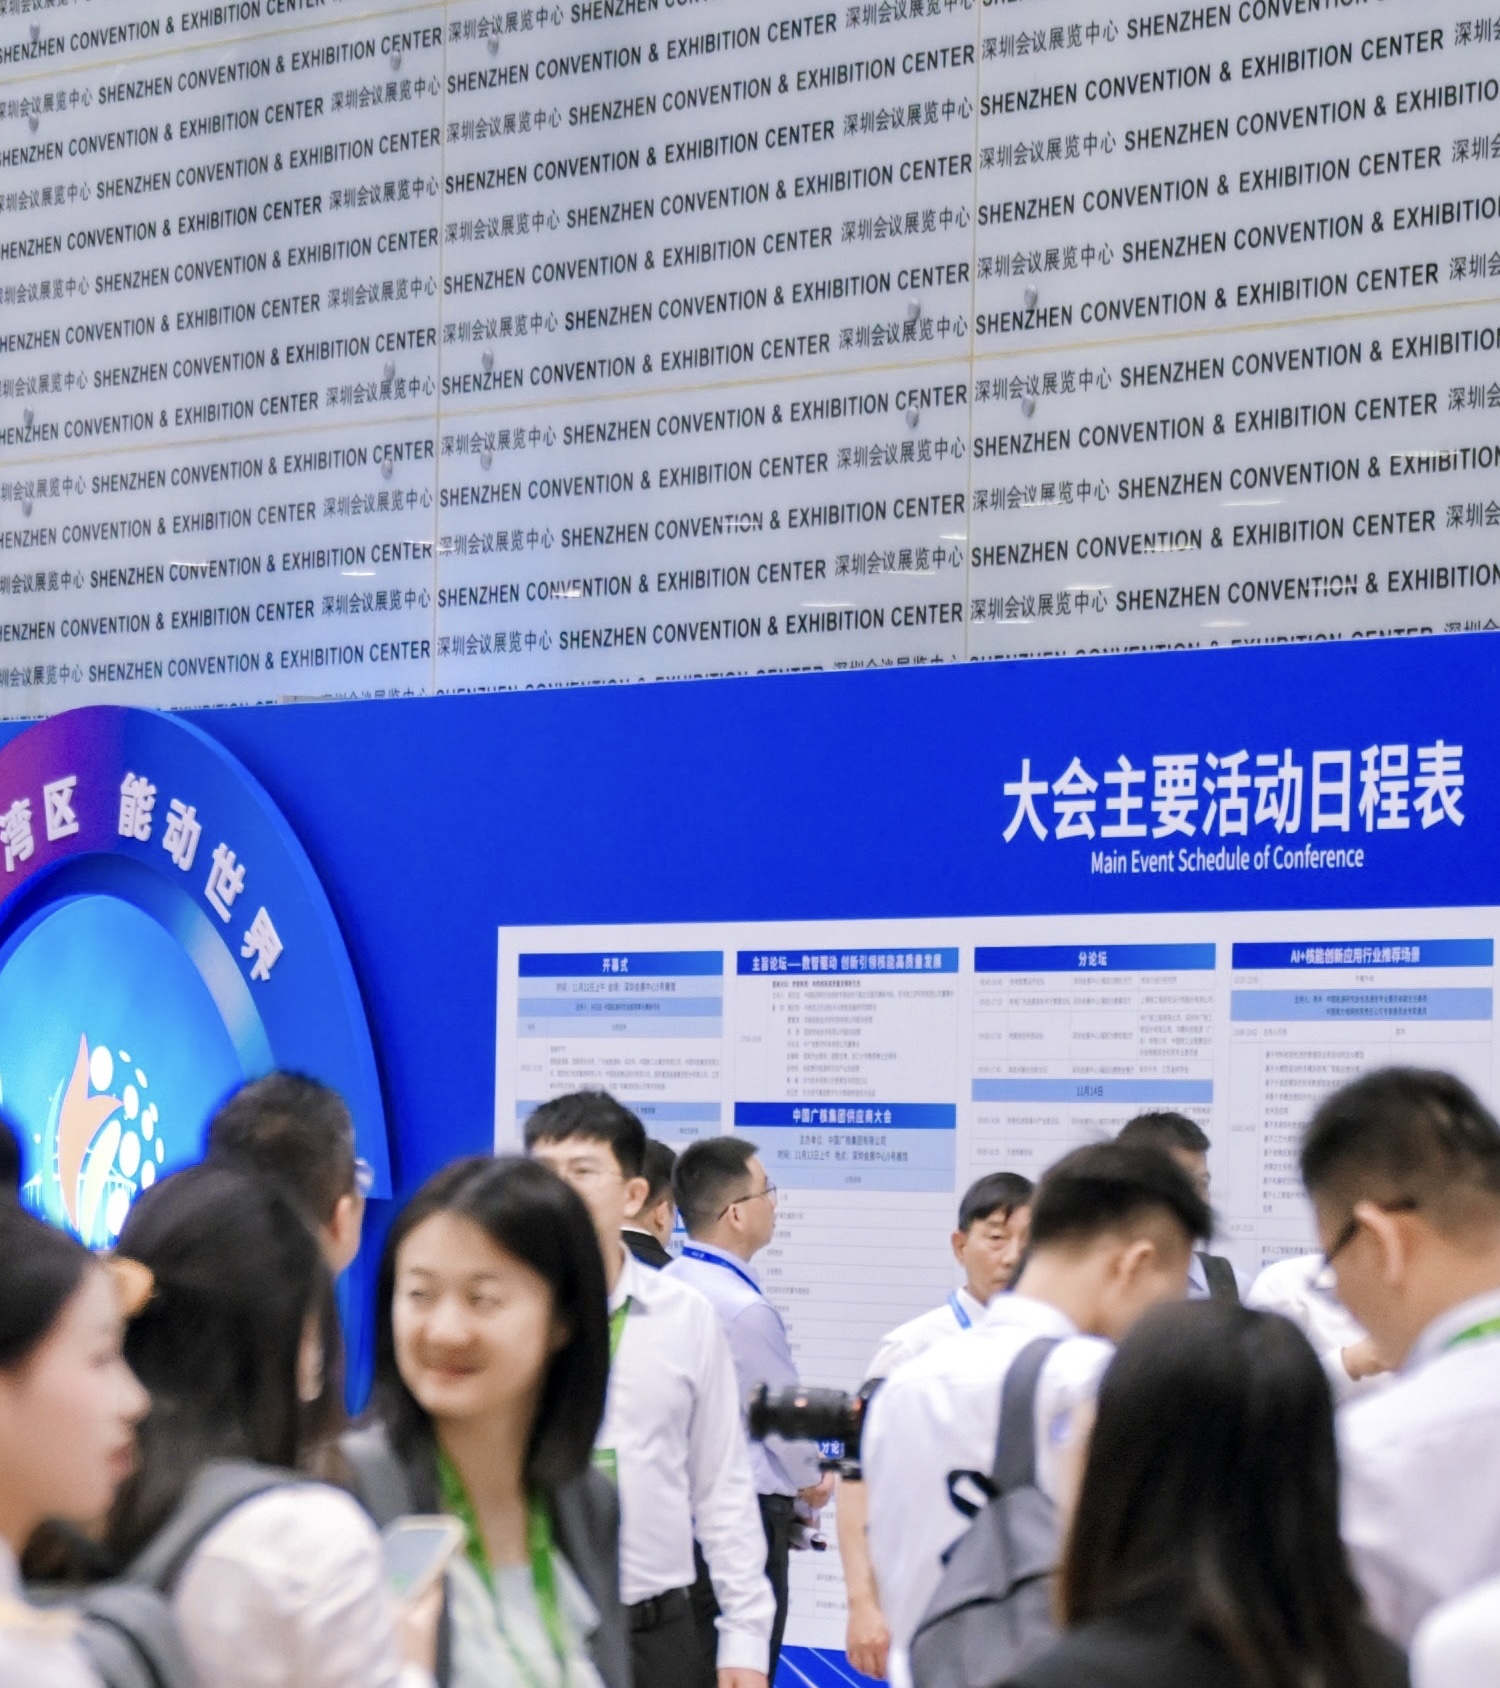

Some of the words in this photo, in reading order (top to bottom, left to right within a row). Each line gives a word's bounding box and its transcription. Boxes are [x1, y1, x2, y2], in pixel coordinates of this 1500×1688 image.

[62, 518, 152, 544] CONVENTION
[157, 516, 167, 536] &
[172, 508, 252, 534] EXHIBITION
[257, 501, 316, 526] CENTER
[323, 488, 433, 517] 深圳会议展览中心
[559, 625, 647, 651] SHENZHEN
[652, 617, 761, 645] CONVENTION
[767, 615, 779, 637] &
[785, 607, 885, 635] EXHIBITION
[890, 602, 963, 628] CENTER
[1002, 739, 1465, 843] 大会主要活动日程表
[117, 771, 284, 982] 能动世界
[1091, 850, 1127, 875] Main
[1130, 848, 1175, 873] Event
[1178, 846, 1250, 872] Schedule
[1253, 844, 1271, 870] of
[1273, 842, 1365, 870] Conference
[602, 957, 628, 973] 开幕式
[1077, 950, 1108, 968] 分论坛
[1076, 1085, 1104, 1098] 11月14日
